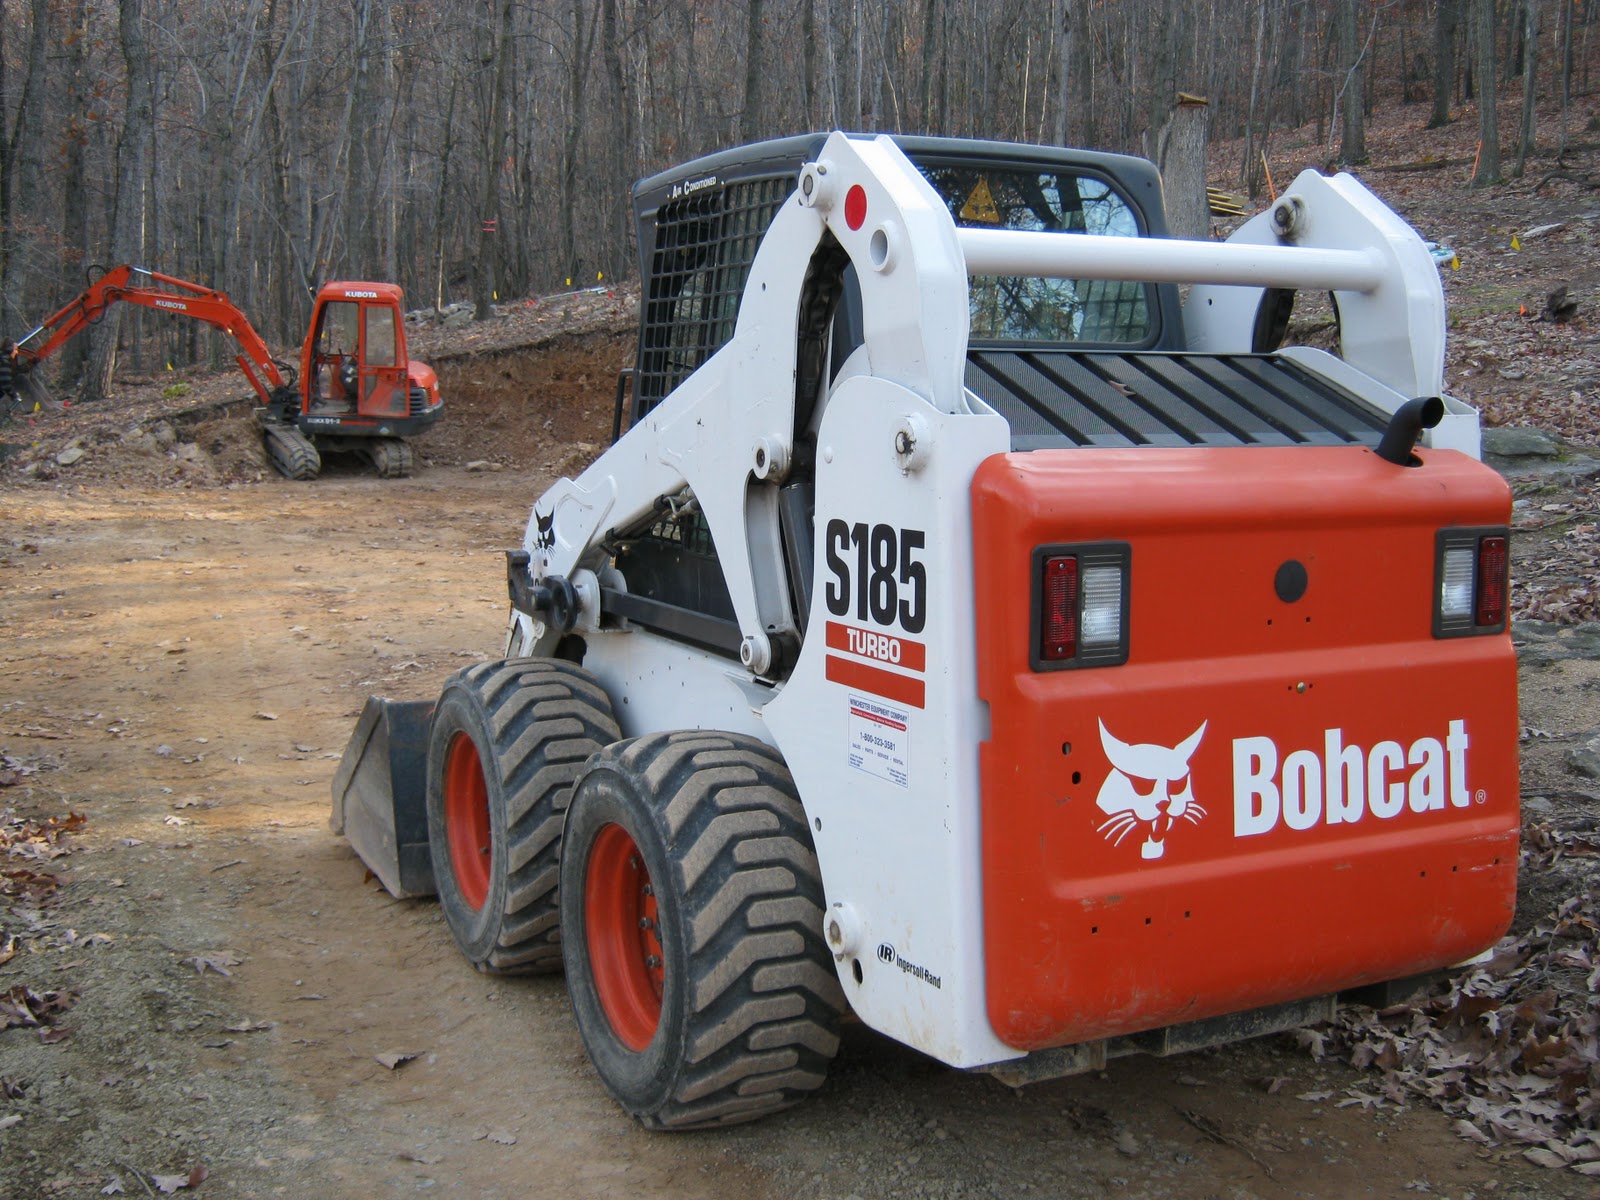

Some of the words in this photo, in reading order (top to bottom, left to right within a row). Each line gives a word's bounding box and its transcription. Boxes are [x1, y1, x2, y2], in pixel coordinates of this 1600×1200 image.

[155, 300, 187, 310] KUBOTA
[345, 290, 378, 298] KUBOTA
[826, 518, 927, 634] S185
[847, 628, 901, 663] TURBO
[1233, 719, 1470, 838] Bobcat
